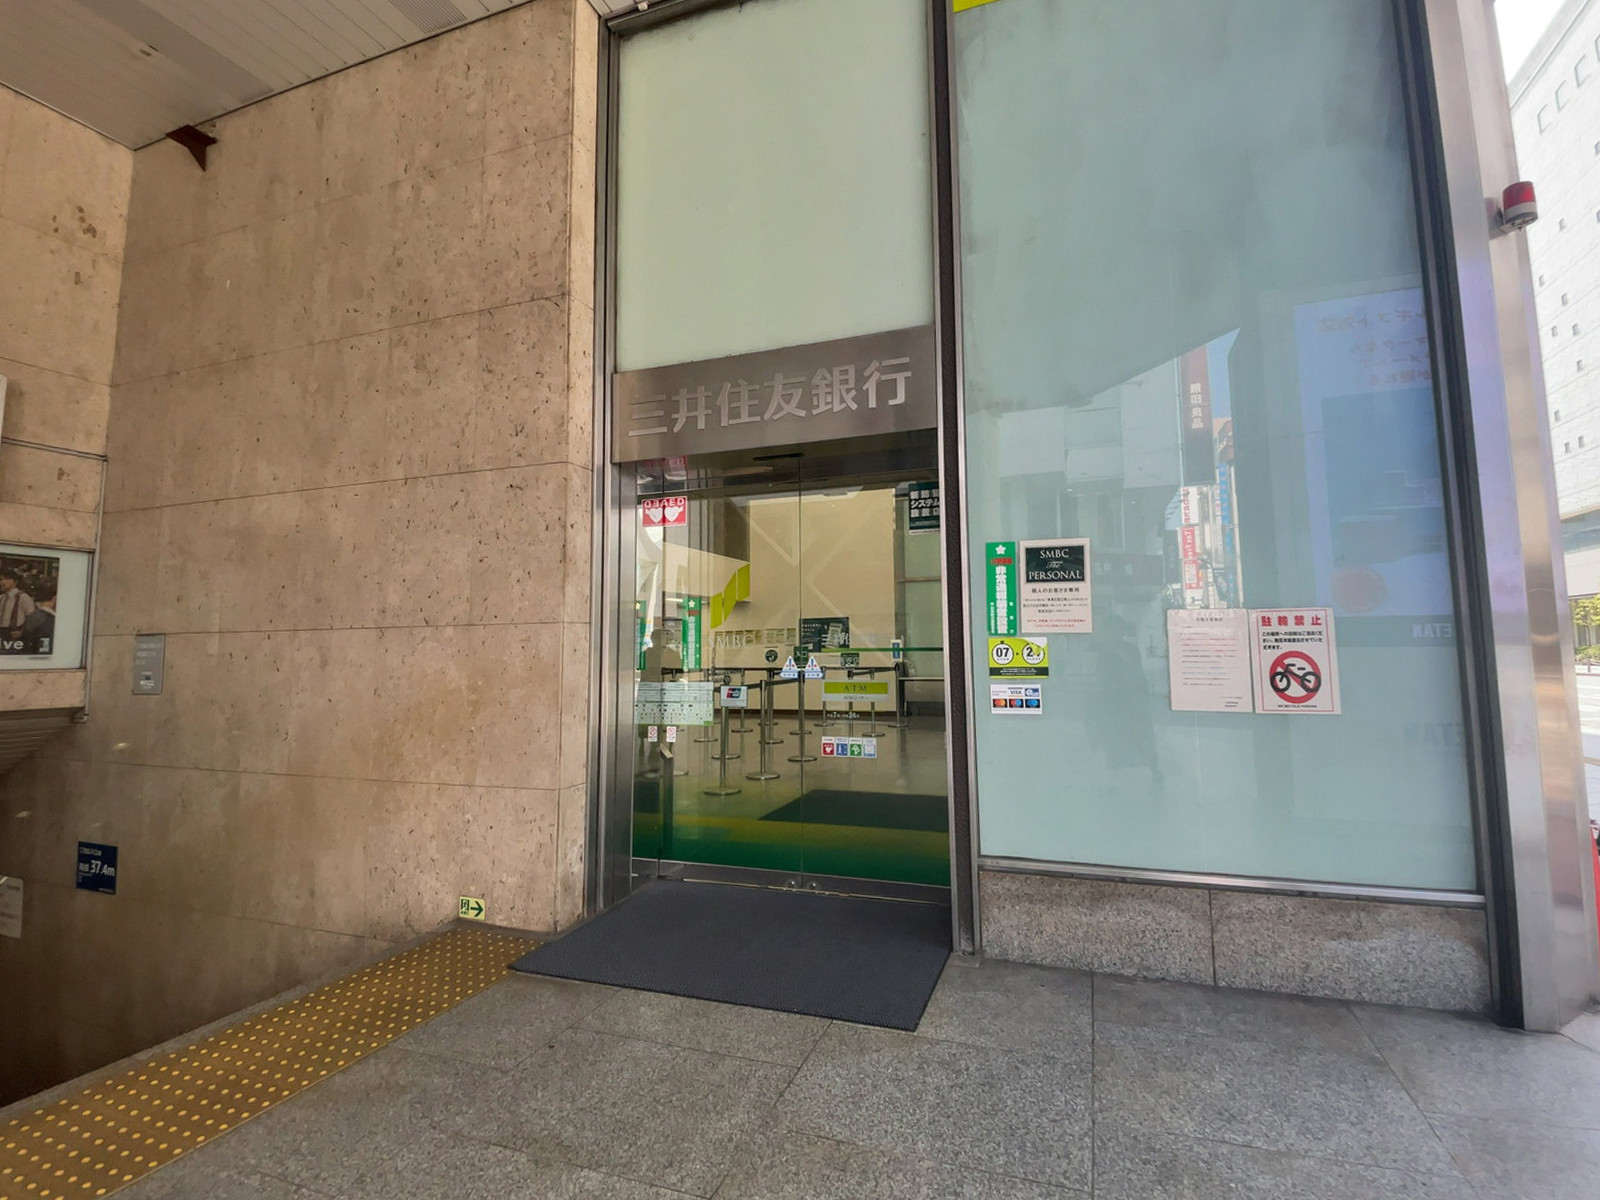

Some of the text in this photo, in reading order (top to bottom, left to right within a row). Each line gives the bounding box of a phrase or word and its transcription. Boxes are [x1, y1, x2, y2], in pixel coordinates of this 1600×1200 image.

[628, 357, 912, 437] 三井住友銀行
[1040, 549, 1069, 559] SMBC
[1028, 570, 1082, 581] PERSONAL
[1261, 614, 1322, 627] 駐輪禁止
[996, 647, 1009, 657] 07
